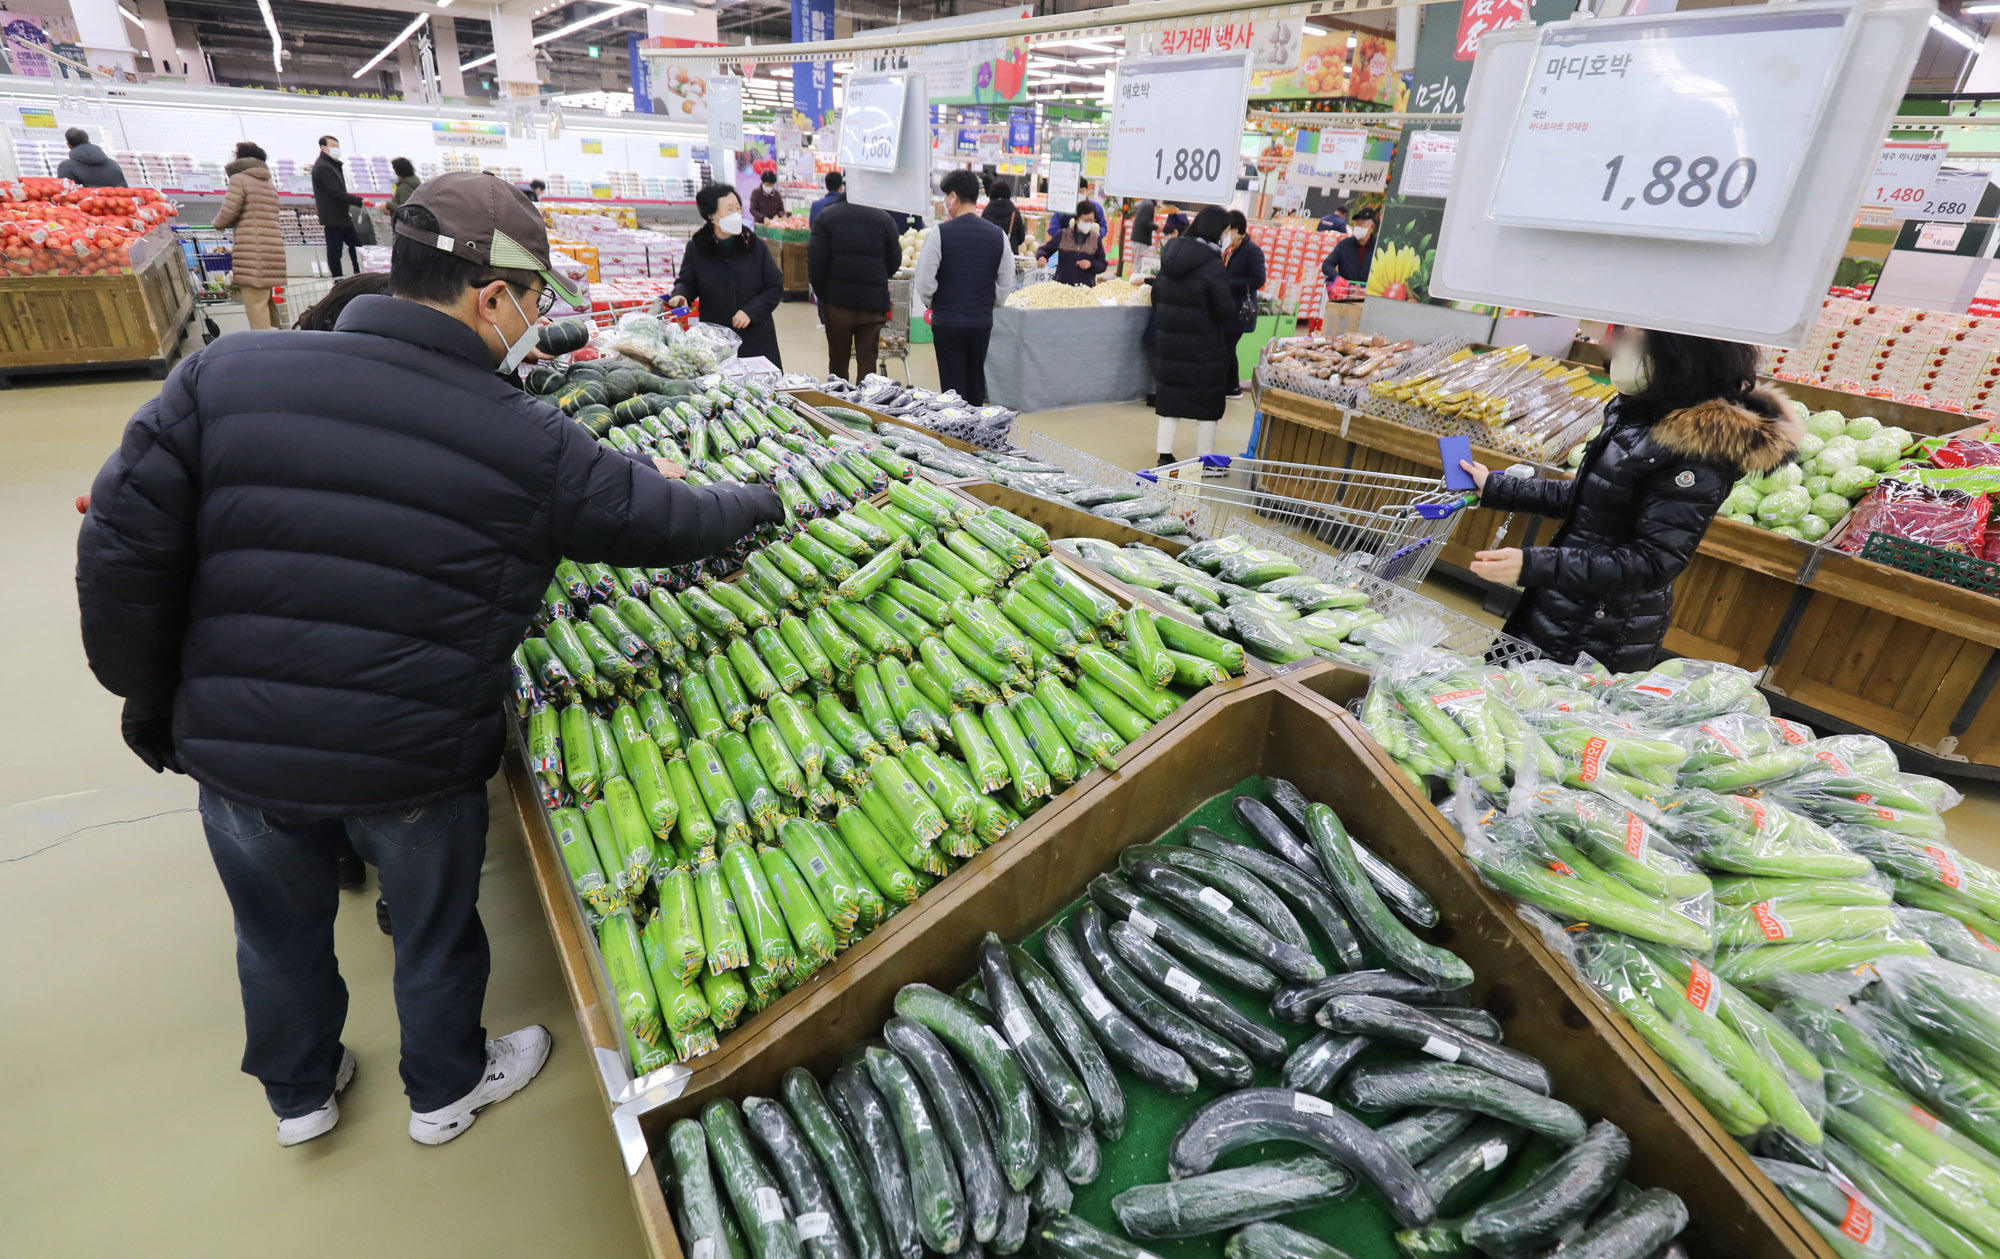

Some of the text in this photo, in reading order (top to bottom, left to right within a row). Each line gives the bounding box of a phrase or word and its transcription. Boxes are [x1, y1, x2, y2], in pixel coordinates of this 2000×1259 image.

[1160, 22, 1254, 55] 직거래 행사
[1546, 53, 1632, 80] 마디호박
[1122, 82, 1151, 100] 애호박
[1532, 110, 1548, 119] 국산
[1528, 122, 1590, 131] 하나로마트 양재점
[862, 135, 892, 160] 1,880
[1343, 160, 1359, 170] 870
[1898, 153, 1937, 161] 미니양배추
[1155, 148, 1221, 184] 1,880
[1601, 155, 1758, 211] 1,880
[1876, 187, 1925, 202] 1,480
[1923, 201, 1967, 215] 2,680
[1581, 738, 1606, 782] 다다기오이
[485, 1072, 505, 1083] FILA
